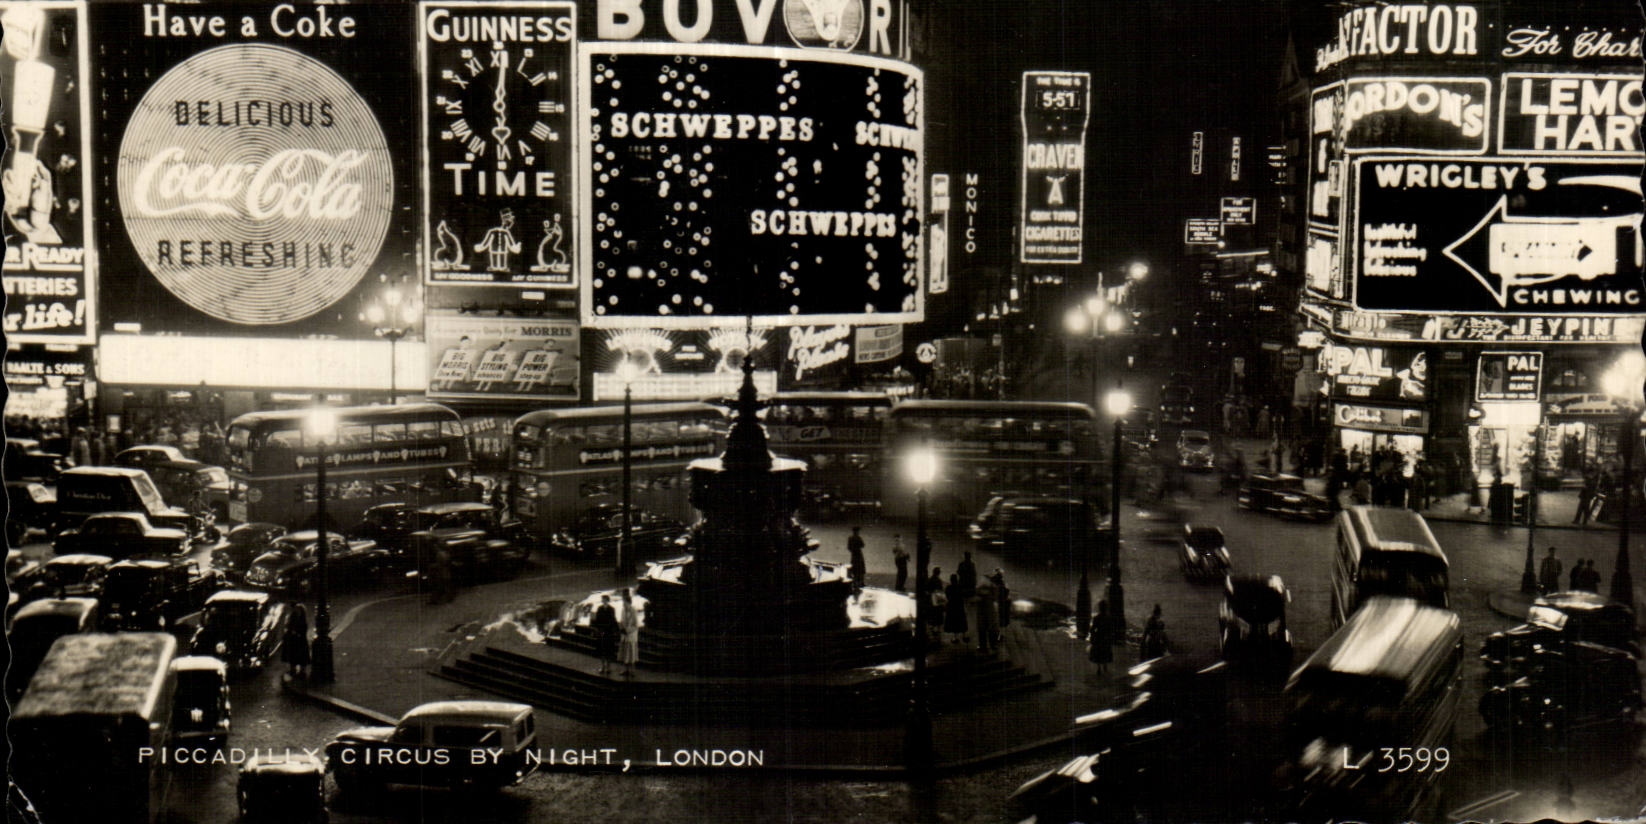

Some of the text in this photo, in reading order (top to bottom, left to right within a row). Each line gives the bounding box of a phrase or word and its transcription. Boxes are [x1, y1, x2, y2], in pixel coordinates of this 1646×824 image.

[143, 4, 357, 38] Have a Coke
[427, 9, 573, 42] GUINNESS
[1502, 28, 1562, 57] For
[175, 100, 336, 128] DELICIOUS
[1343, 81, 1483, 138] ORDON'S
[611, 111, 814, 142] SCHWEPPES
[1534, 114, 1642, 151] HAR
[1027, 143, 1083, 169] CRAVEN
[134, 146, 370, 220] Coca-Cola
[443, 162, 556, 197] TIME
[1375, 162, 1547, 190] WRIGLEY'S
[750, 208, 897, 238] SCHWEPPES
[965, 173, 978, 253] MONICO
[1025, 226, 1081, 241] CIGARETTES
[22, 243, 84, 269] READY
[157, 239, 357, 270] REFRESHING
[448, 273, 494, 281] GOODNESS
[1513, 288, 1640, 305] CHEWING
[22, 299, 86, 330] life!
[520, 326, 573, 337] MORRIS
[54, 363, 85, 375] SONS
[521, 363, 549, 372] POWER
[1331, 346, 1393, 377] PAL
[1507, 356, 1540, 371] PAL
[800, 427, 825, 439] GET
[341, 453, 373, 464] LAMPS
[380, 450, 400, 461] AND
[409, 447, 440, 458] TUBES
